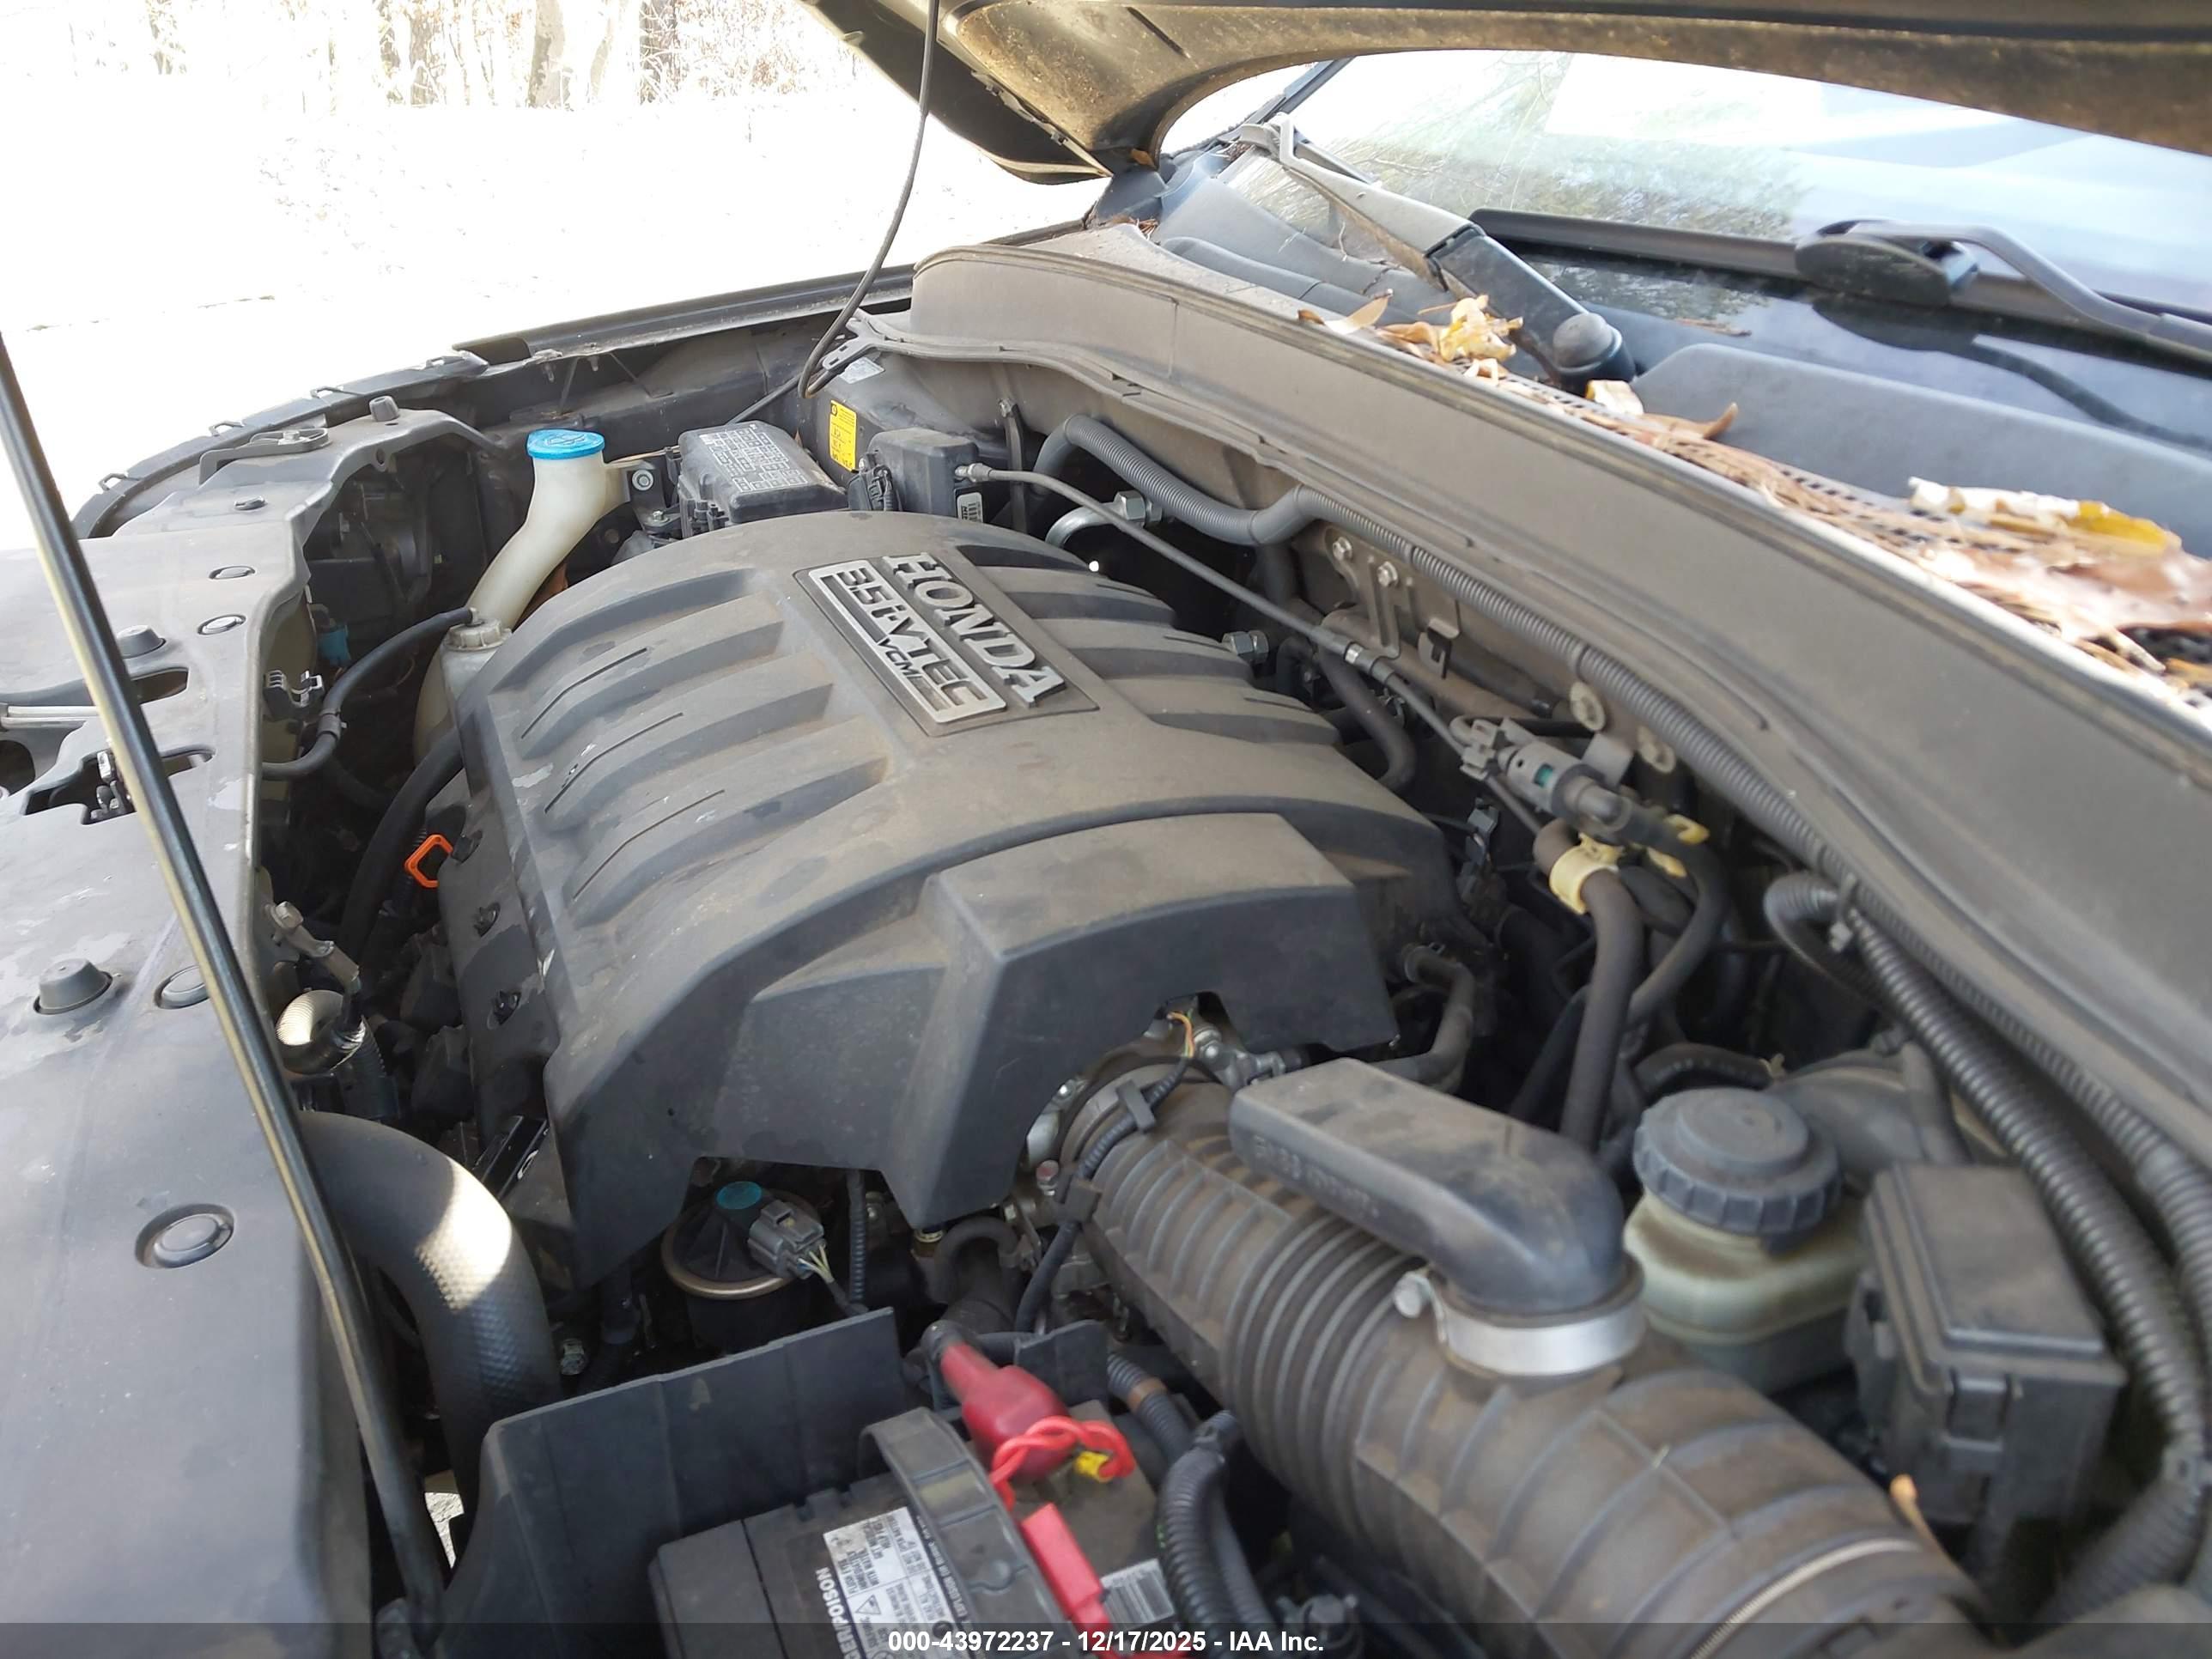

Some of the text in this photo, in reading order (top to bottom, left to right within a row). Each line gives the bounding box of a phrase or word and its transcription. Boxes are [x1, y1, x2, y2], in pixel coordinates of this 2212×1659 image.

[836, 567, 988, 707] 3.5 i-VTEC
[877, 637, 921, 678] VCM
[883, 552, 1066, 708] HONDA
